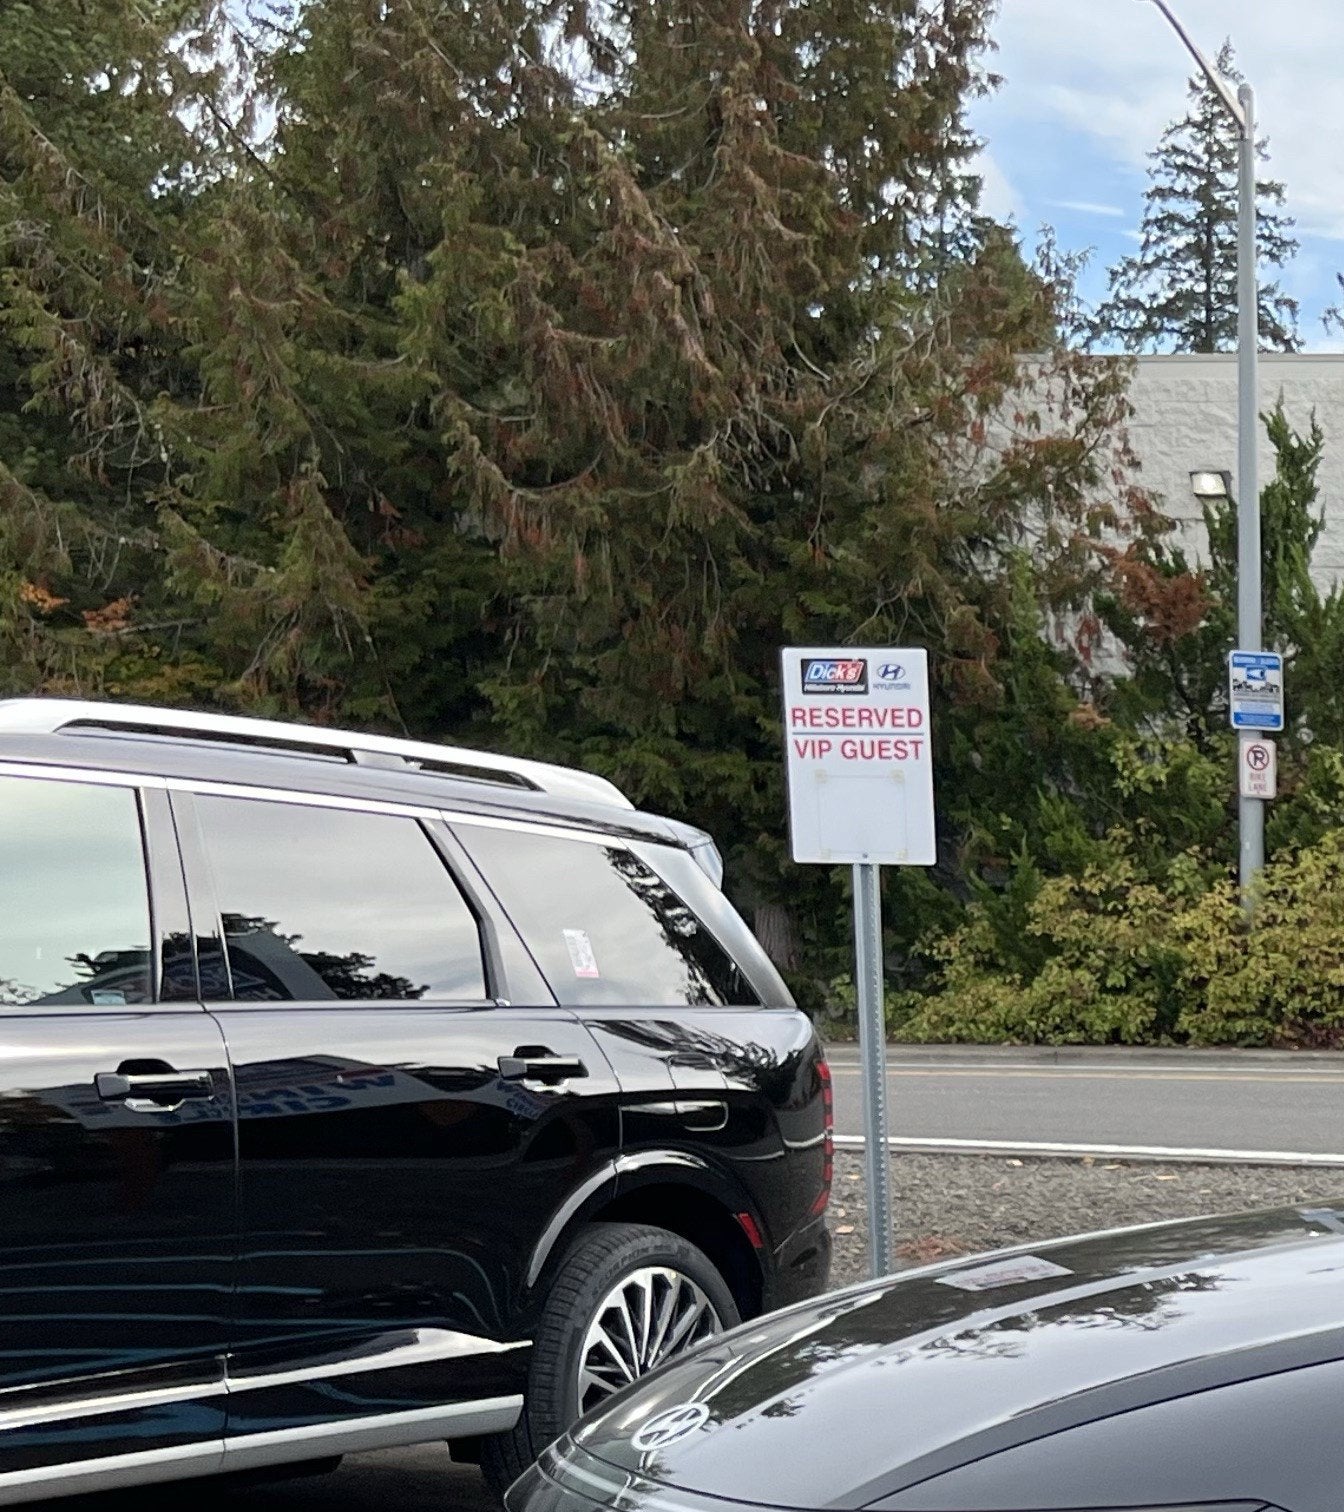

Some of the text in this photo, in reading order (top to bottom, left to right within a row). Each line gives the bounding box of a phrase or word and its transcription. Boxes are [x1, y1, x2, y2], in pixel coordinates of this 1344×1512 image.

[791, 707, 923, 728] RESERVED
[794, 739, 923, 760] VIP GUEST
